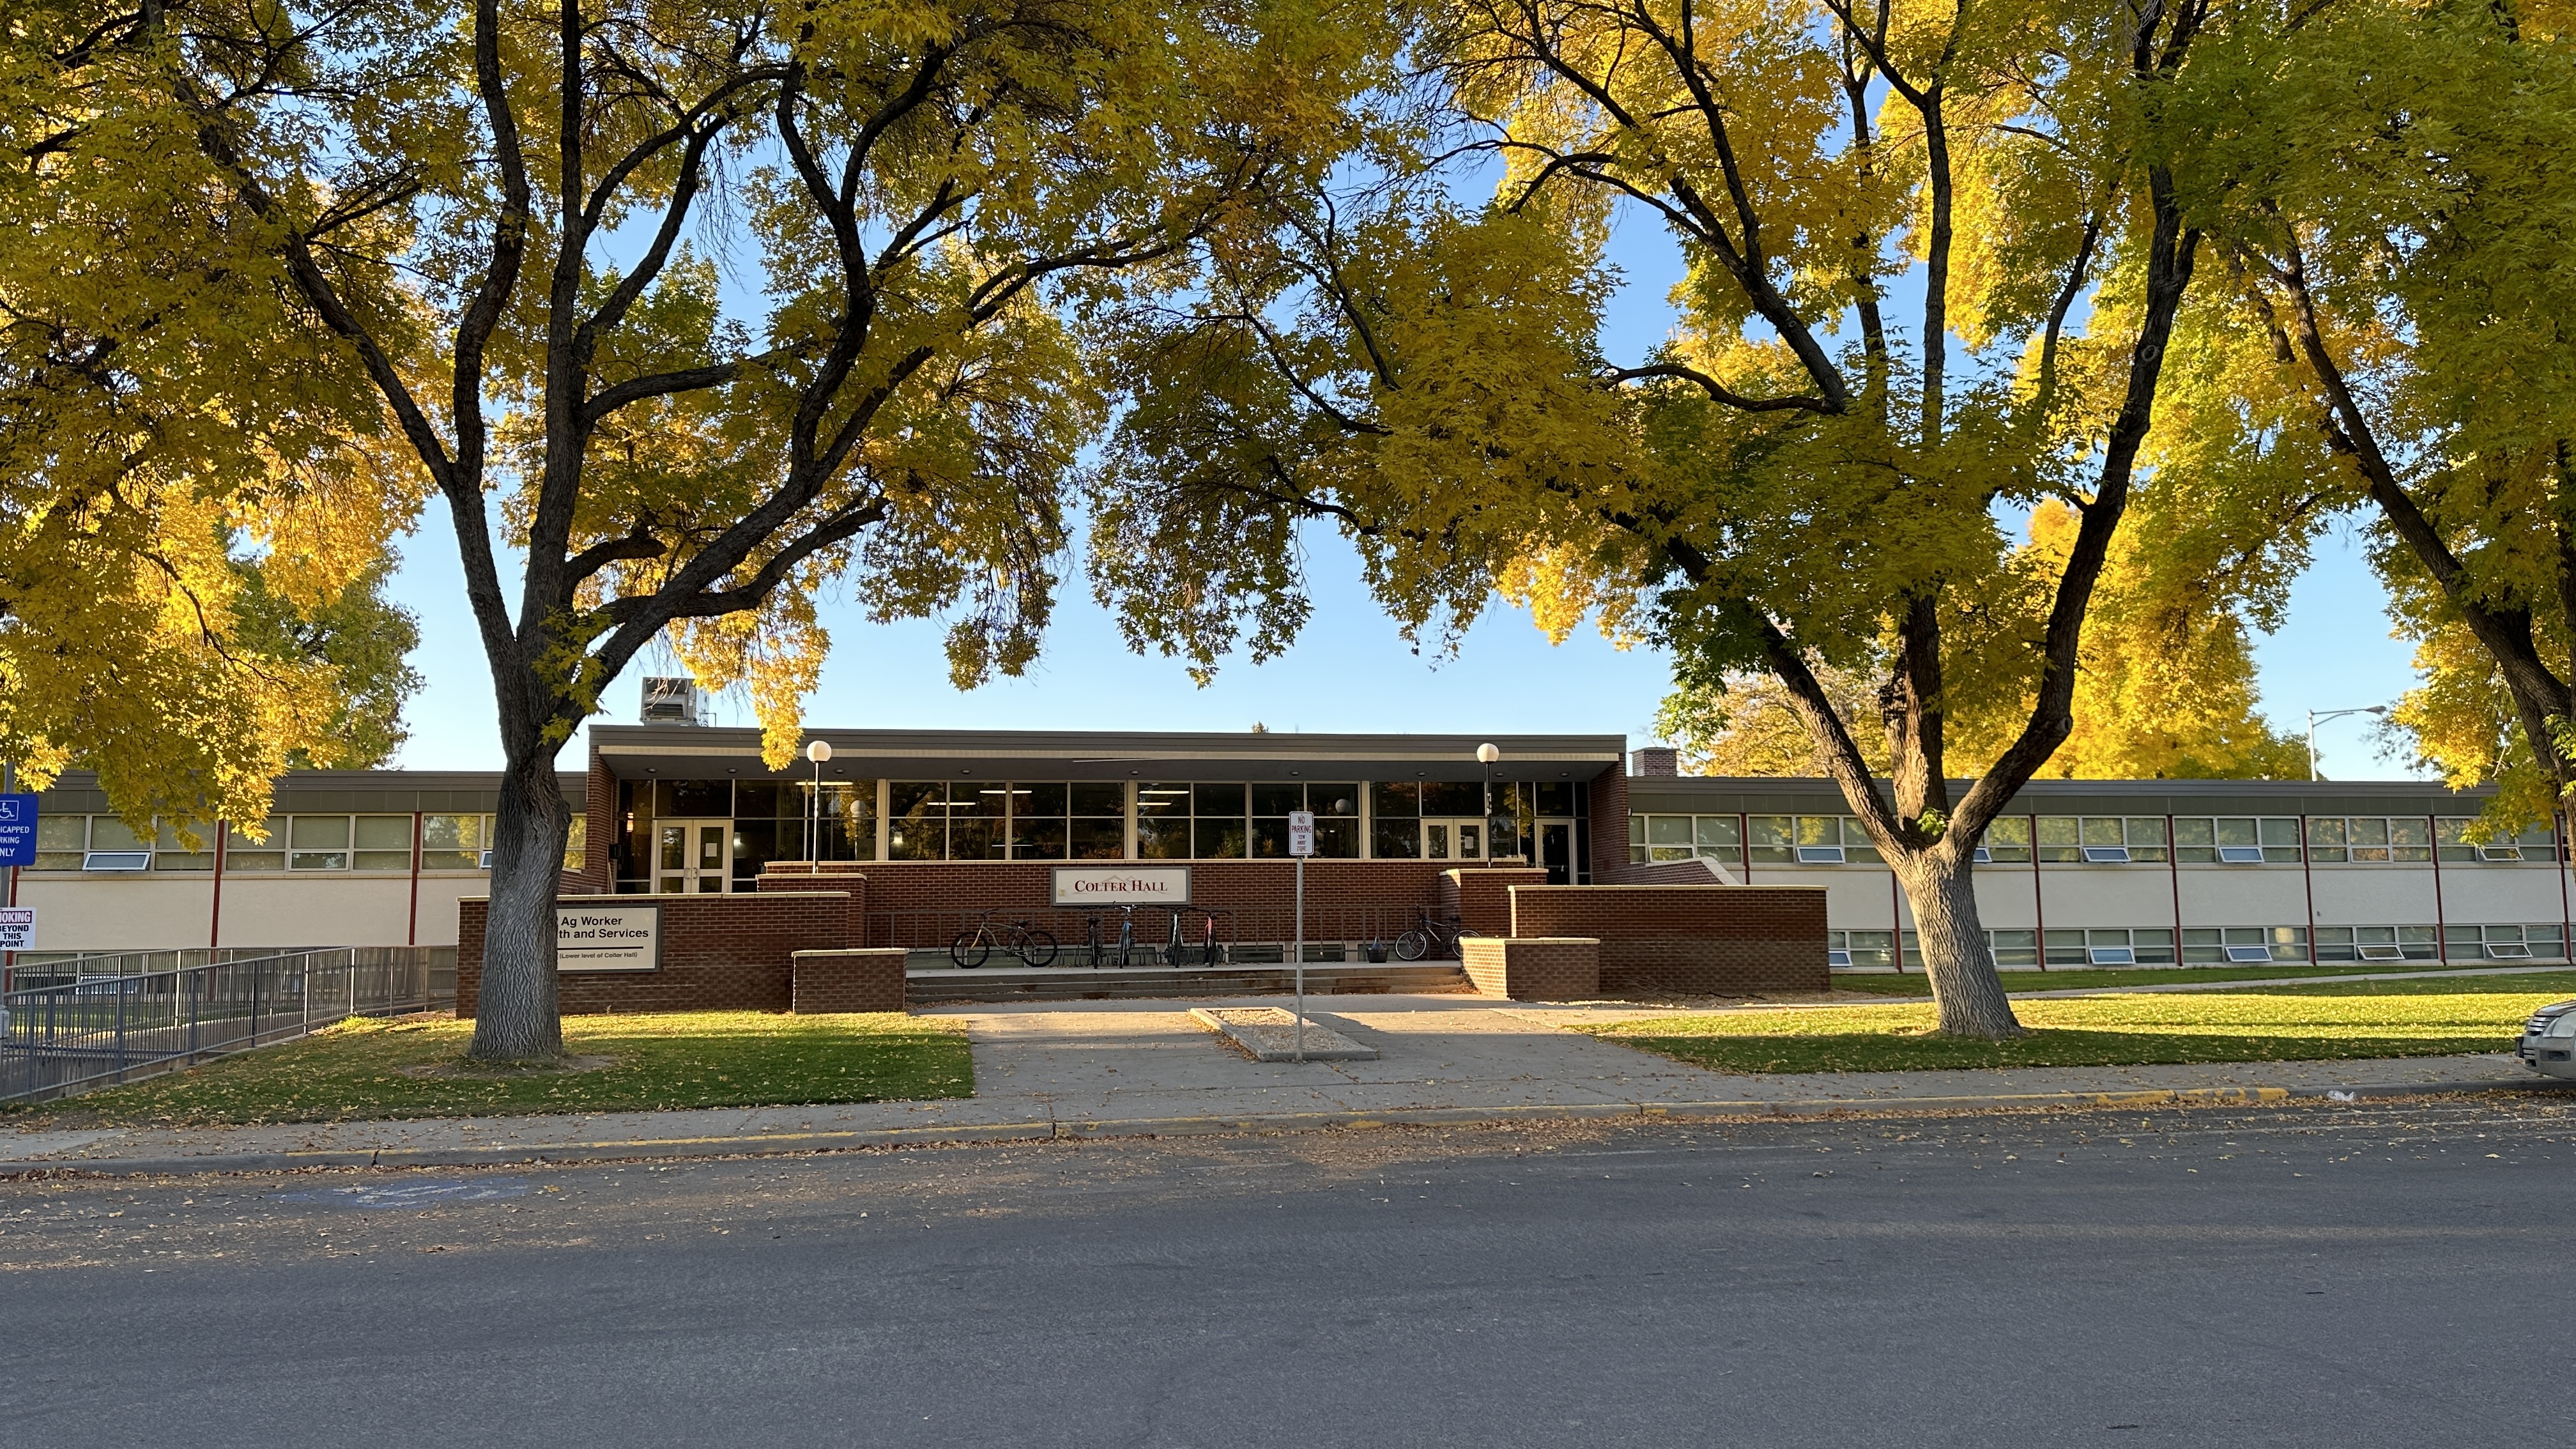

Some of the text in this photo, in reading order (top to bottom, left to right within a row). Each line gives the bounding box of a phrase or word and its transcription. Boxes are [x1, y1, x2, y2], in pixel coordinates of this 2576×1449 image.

[0, 825, 30, 834] ICAPPED
[0, 848, 15, 857] NLY
[0, 912, 31, 923] OKING
[561, 916, 623, 928] Ag Worker
[573, 929, 595, 939] and
[599, 928, 649, 938] Services
